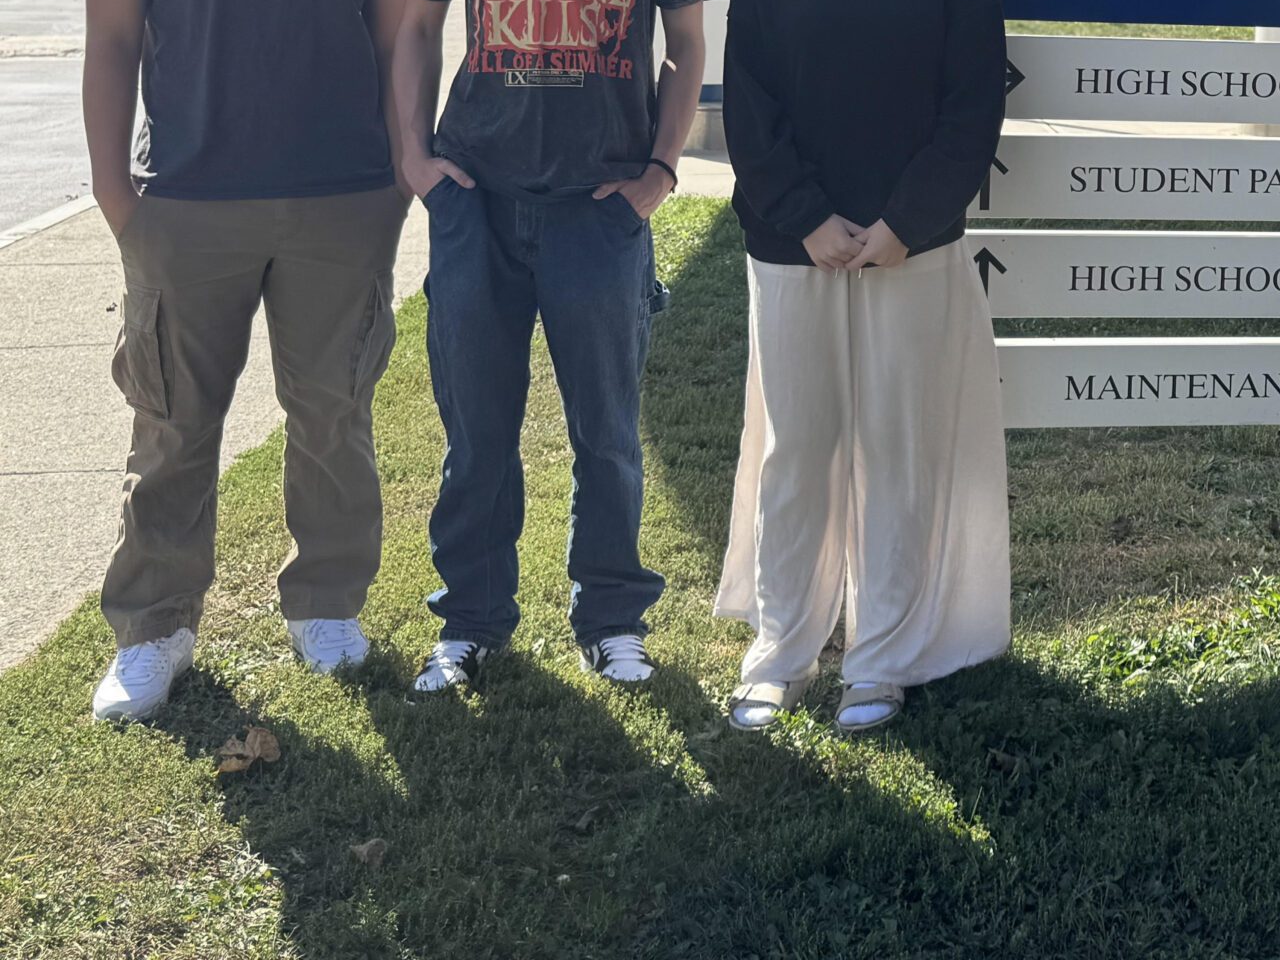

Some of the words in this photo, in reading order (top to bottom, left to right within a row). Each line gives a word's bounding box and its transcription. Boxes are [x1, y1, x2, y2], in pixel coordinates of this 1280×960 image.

[508, 71, 527, 84] IX
[1075, 68, 1172, 96] HIGH
[1069, 166, 1240, 194] STUDENT
[1068, 265, 1165, 292] HIGH
